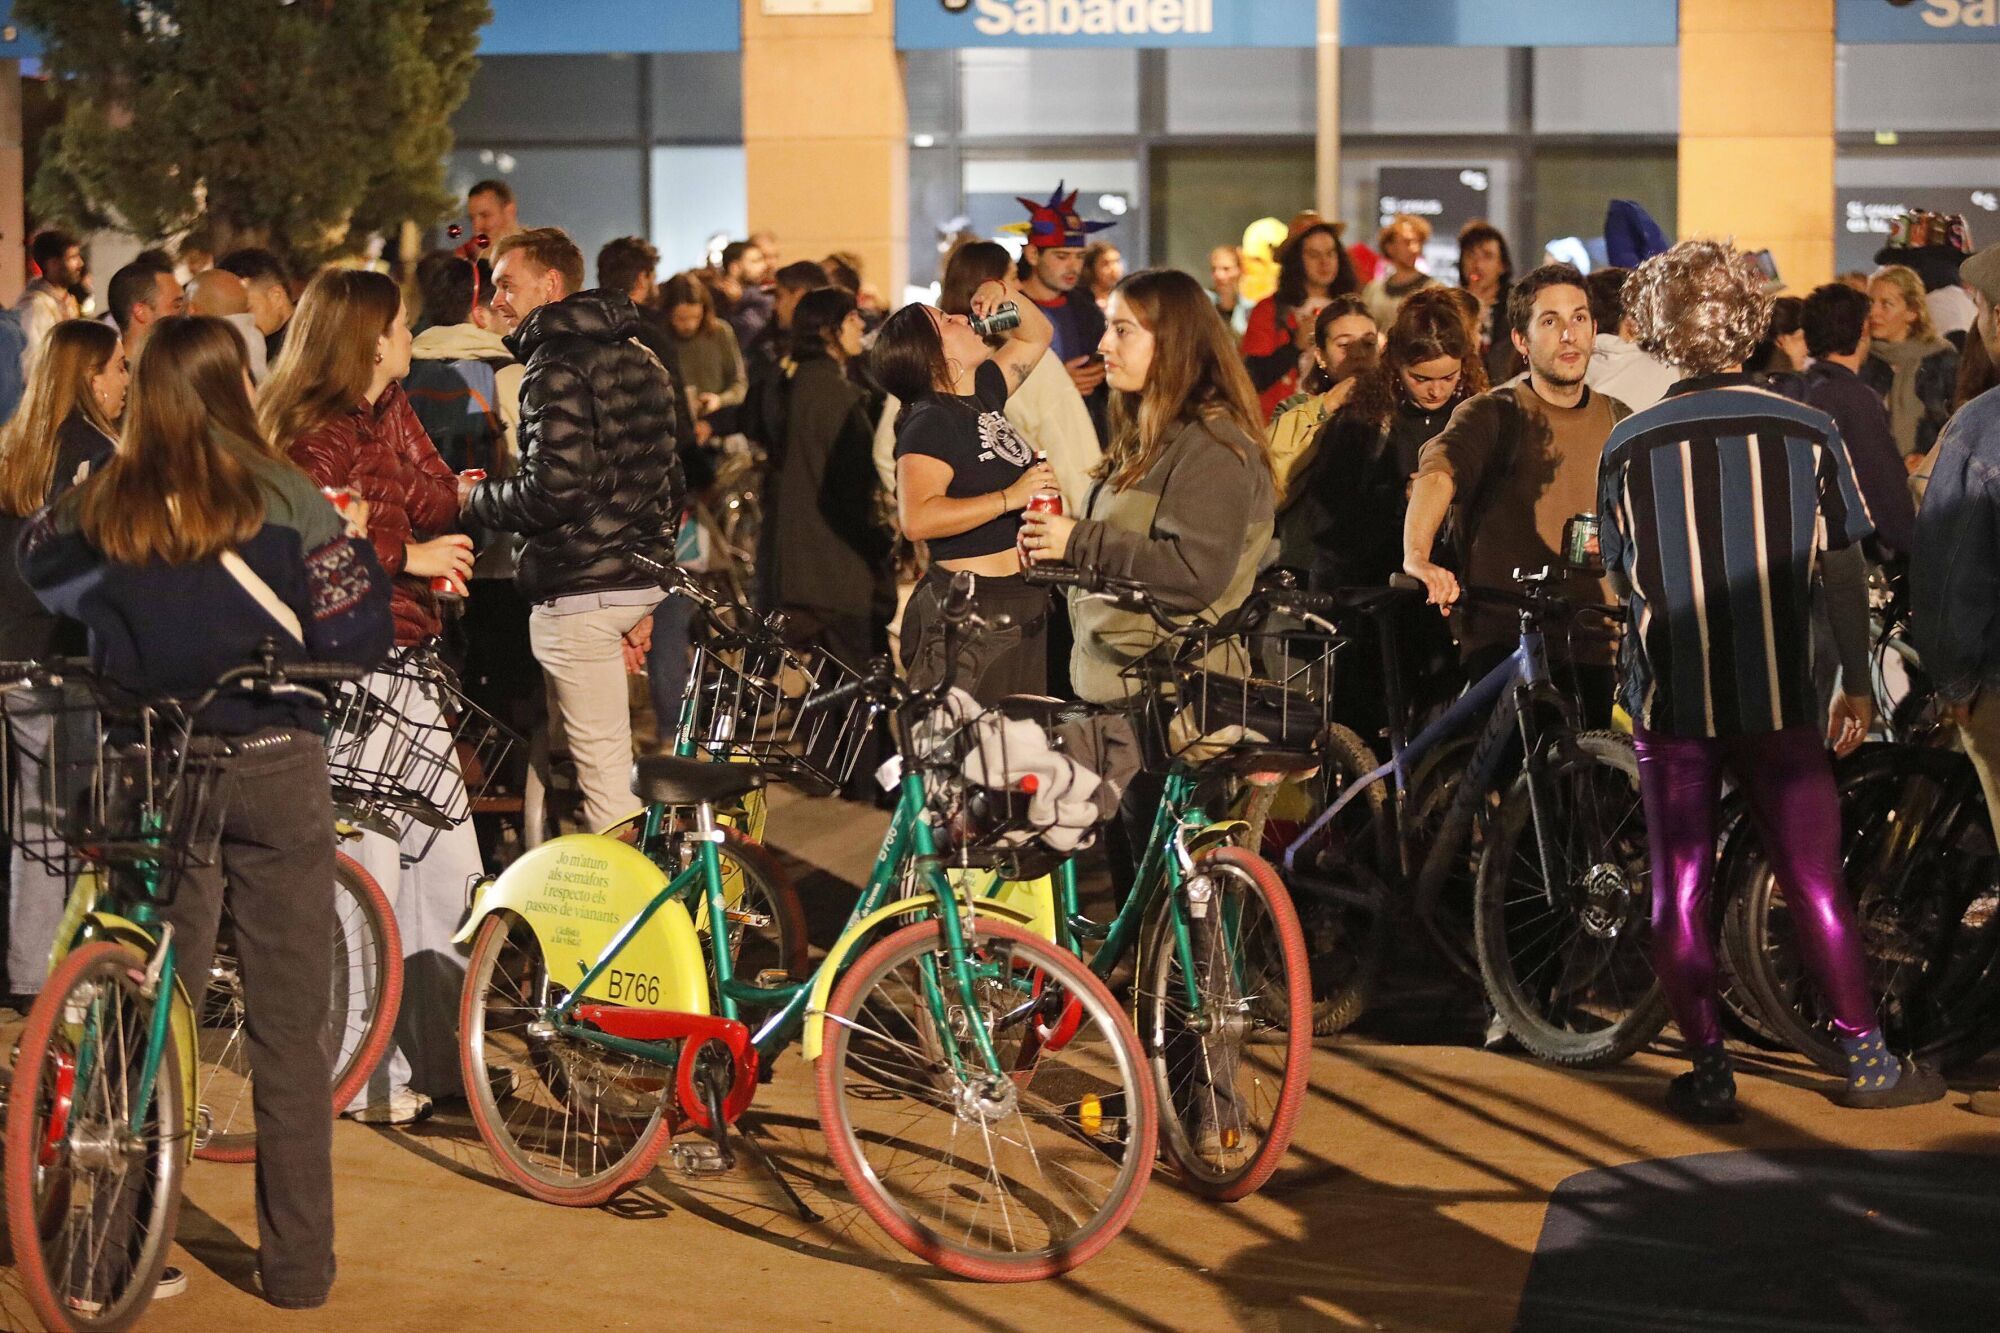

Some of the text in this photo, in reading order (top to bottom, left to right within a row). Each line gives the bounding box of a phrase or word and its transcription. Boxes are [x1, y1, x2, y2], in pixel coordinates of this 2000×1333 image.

[973, 0, 1213, 36] Sabadell
[557, 852, 608, 870] Jo m'aturo
[548, 867, 563, 881] als
[549, 886, 590, 903] respecto
[591, 889, 607, 904] els
[525, 900, 620, 924] passos de vianants
[608, 969, 660, 1005] B766
